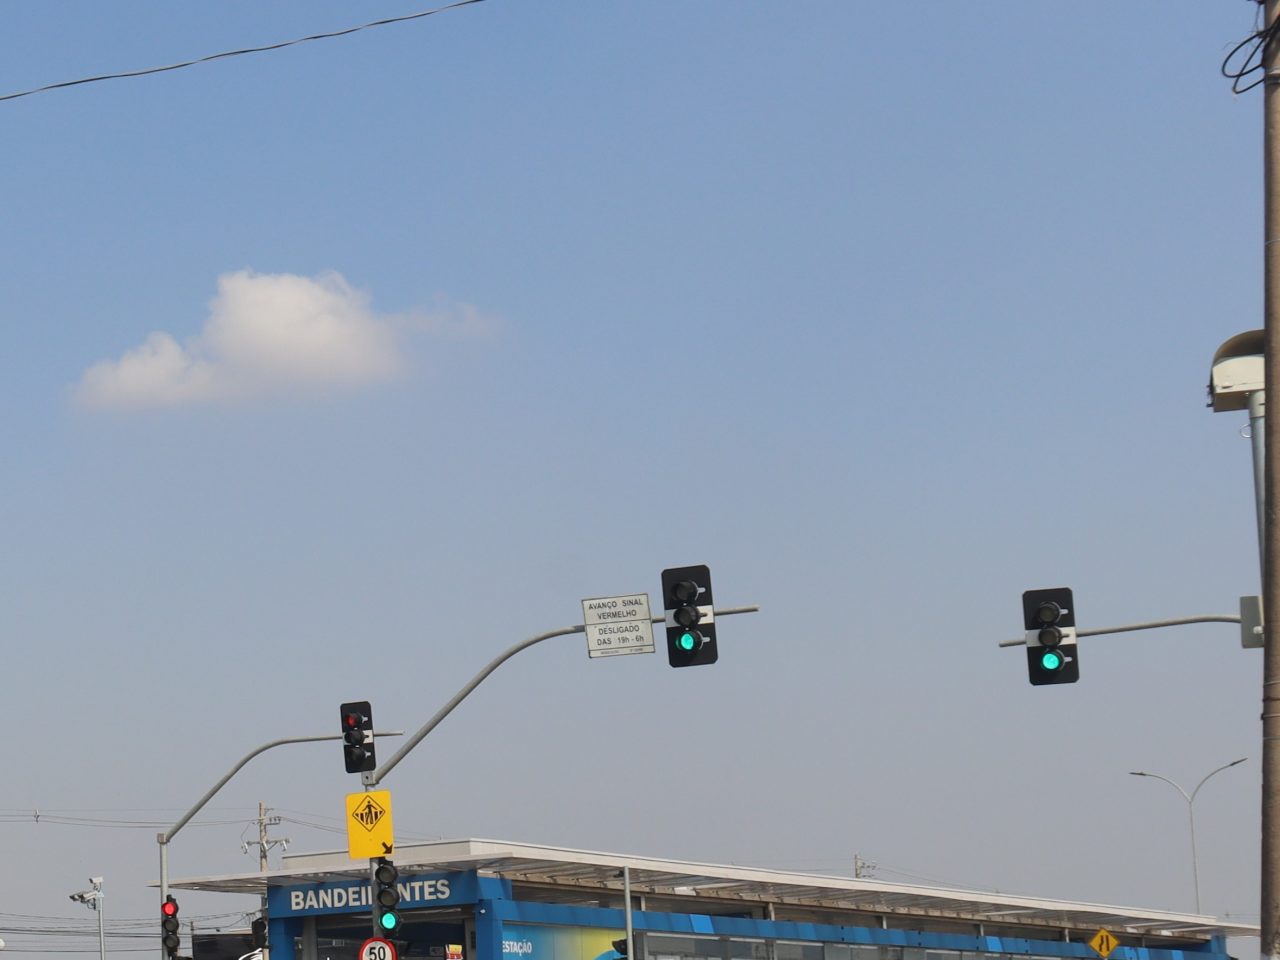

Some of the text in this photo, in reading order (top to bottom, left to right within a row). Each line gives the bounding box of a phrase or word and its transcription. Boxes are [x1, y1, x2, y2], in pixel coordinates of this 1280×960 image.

[588, 599, 643, 610] AVANÇO SINAL
[597, 609, 637, 620] VERMELHO
[598, 625, 640, 635] DESLIGADO
[597, 638, 612, 646] DAS
[290, 879, 450, 911] BANDEINTES
